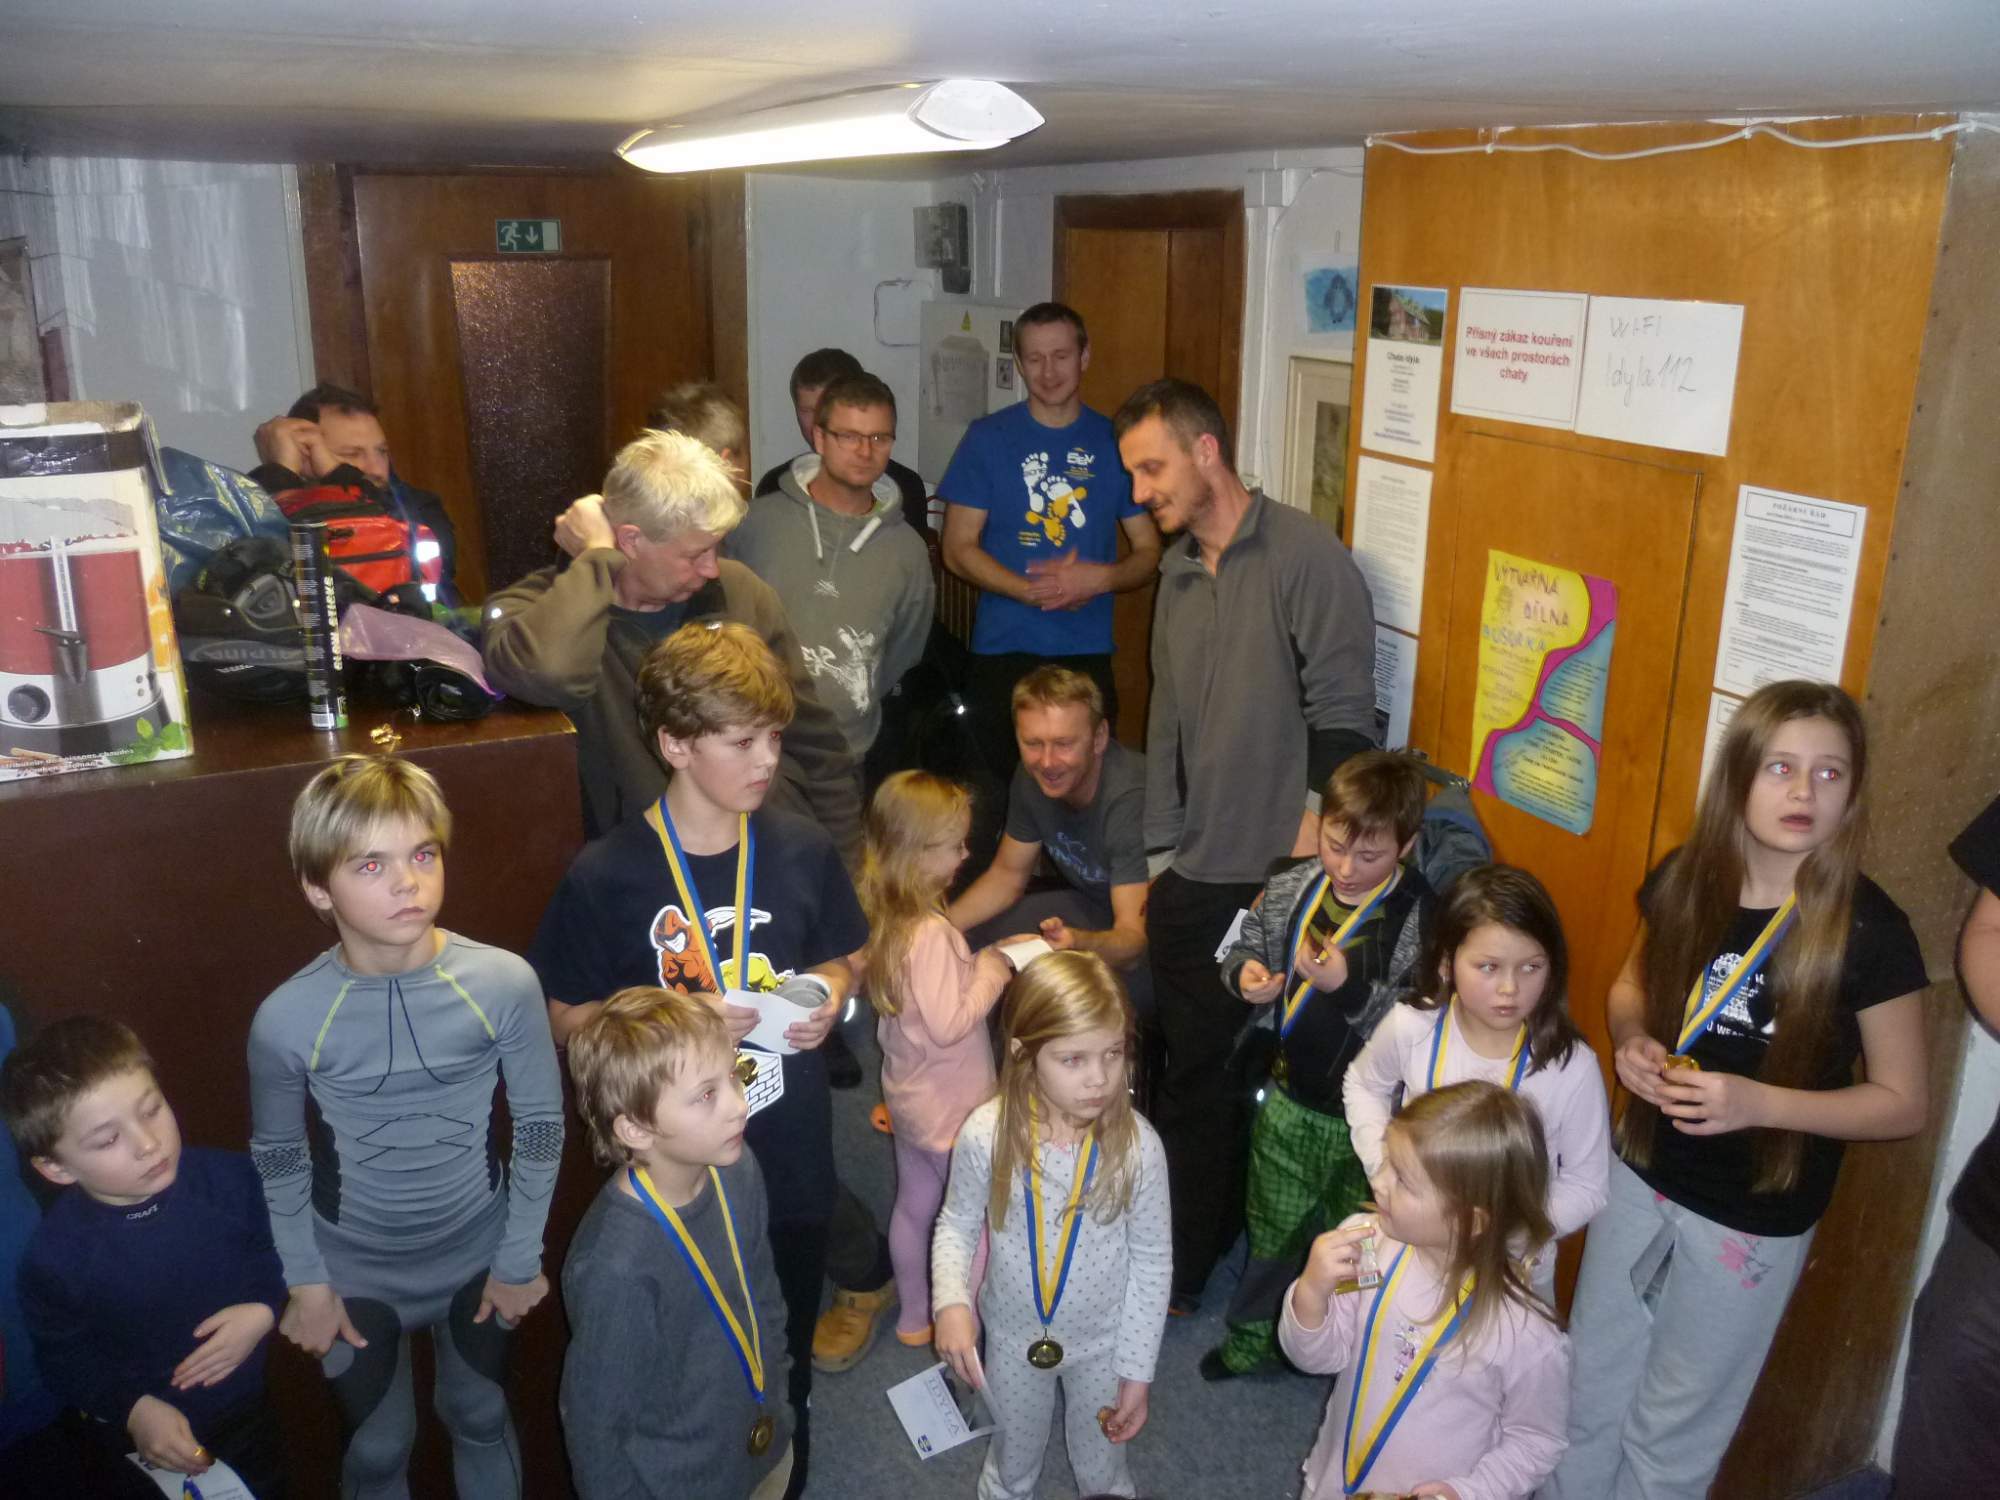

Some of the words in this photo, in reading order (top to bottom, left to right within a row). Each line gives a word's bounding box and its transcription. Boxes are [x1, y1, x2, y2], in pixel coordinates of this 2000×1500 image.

[1499, 330, 1529, 345] zákaz
[1531, 331, 1573, 348] kouření
[1465, 346, 1478, 357] ve
[1480, 346, 1509, 361] všech
[1511, 351, 1571, 367] prostorách
[1499, 366, 1528, 383] chaty
[323, 576, 339, 627] STICKS
[329, 631, 344, 671] GLOW
[126, 1203, 158, 1220] CRAFT
